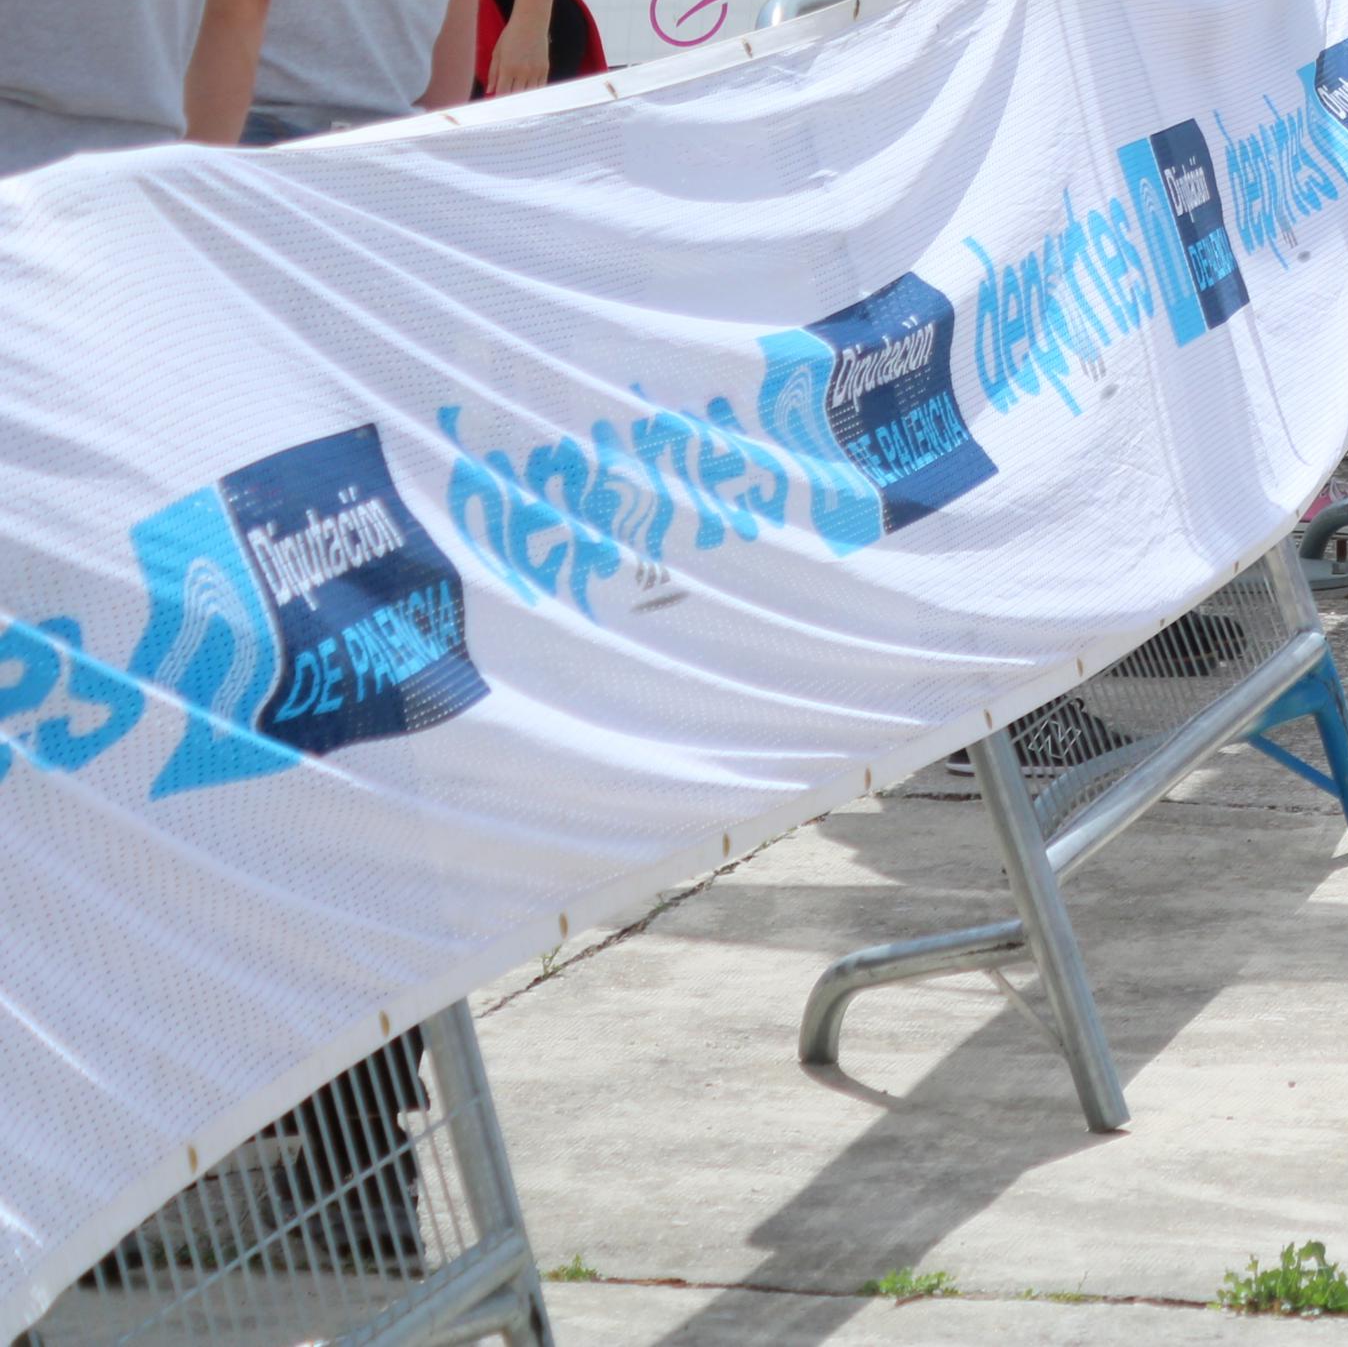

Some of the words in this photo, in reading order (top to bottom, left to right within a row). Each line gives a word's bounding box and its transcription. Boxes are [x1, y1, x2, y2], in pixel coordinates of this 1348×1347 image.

[831, 316, 934, 413] Diputación
[875, 391, 969, 476] PALENCIA
[248, 486, 405, 612] Diputación
[273, 636, 345, 724] DE
